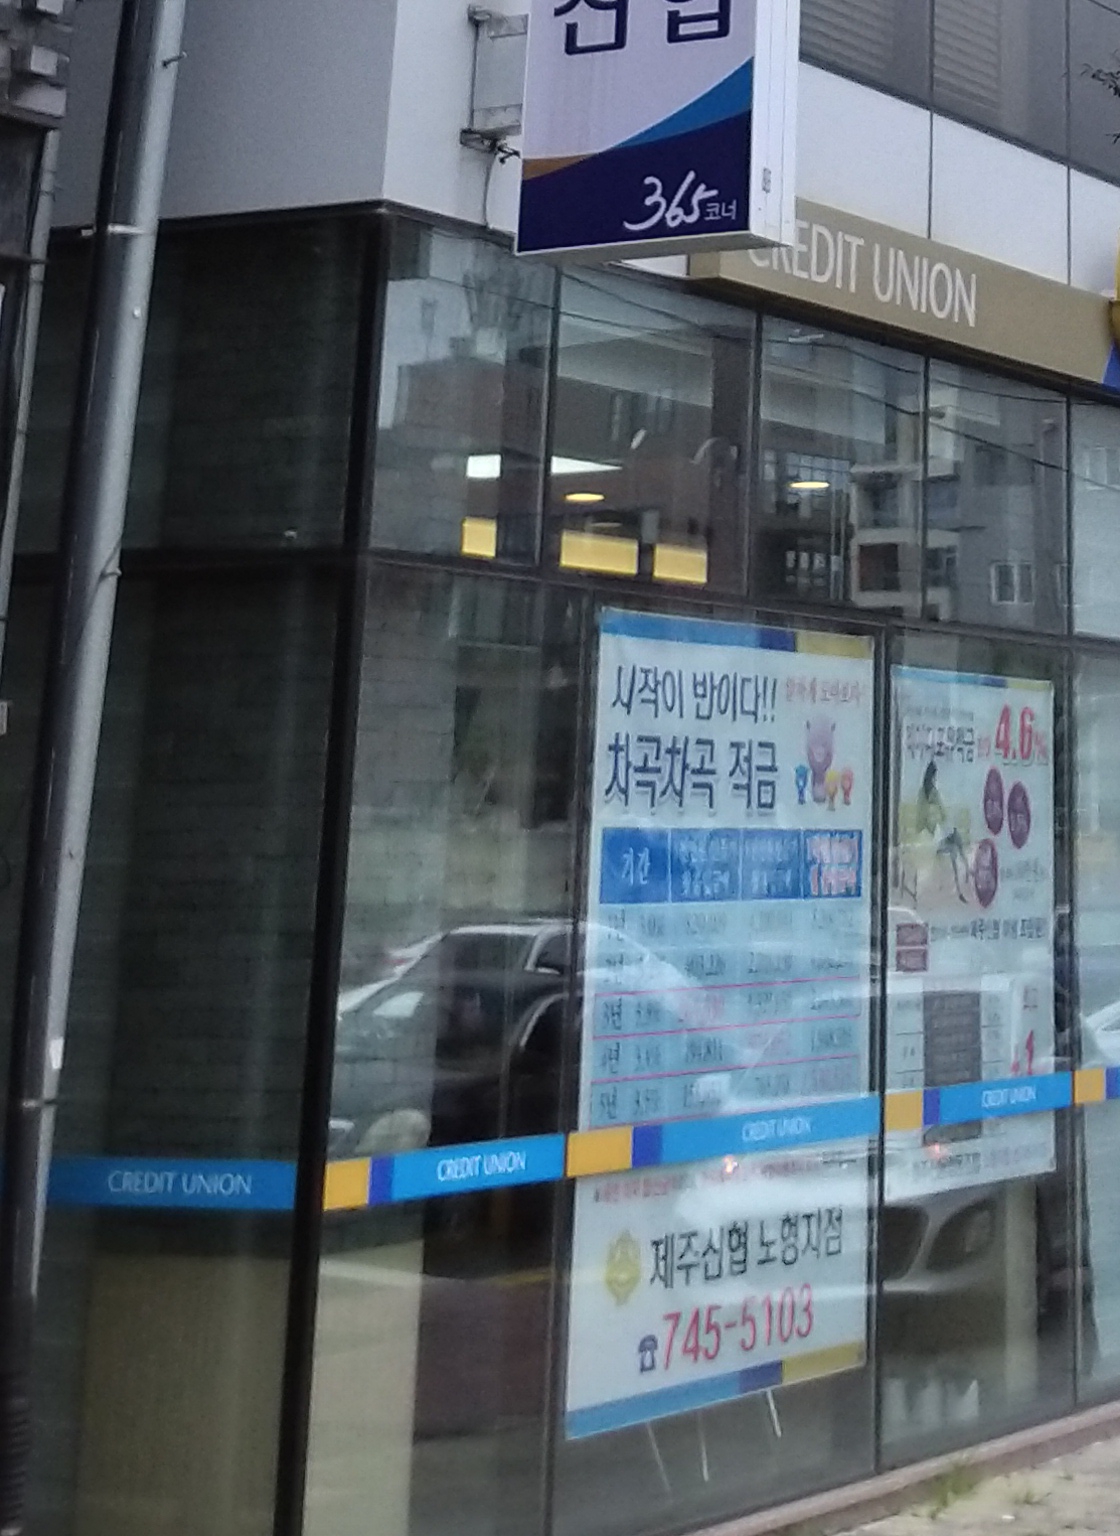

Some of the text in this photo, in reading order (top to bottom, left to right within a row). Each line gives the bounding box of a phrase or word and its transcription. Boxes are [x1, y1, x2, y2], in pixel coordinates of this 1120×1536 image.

[874, 242, 978, 328] UNION
[611, 663, 685, 720] 시작이
[692, 670, 778, 724] 반이다!!
[604, 731, 779, 813] 차곡차곡 적금
[106, 1169, 253, 1196] CREDIT UNION
[436, 1149, 527, 1182] CREDIT UNION
[650, 1206, 844, 1289] 제주신협 노형지점
[662, 1282, 815, 1370] 745-5103
